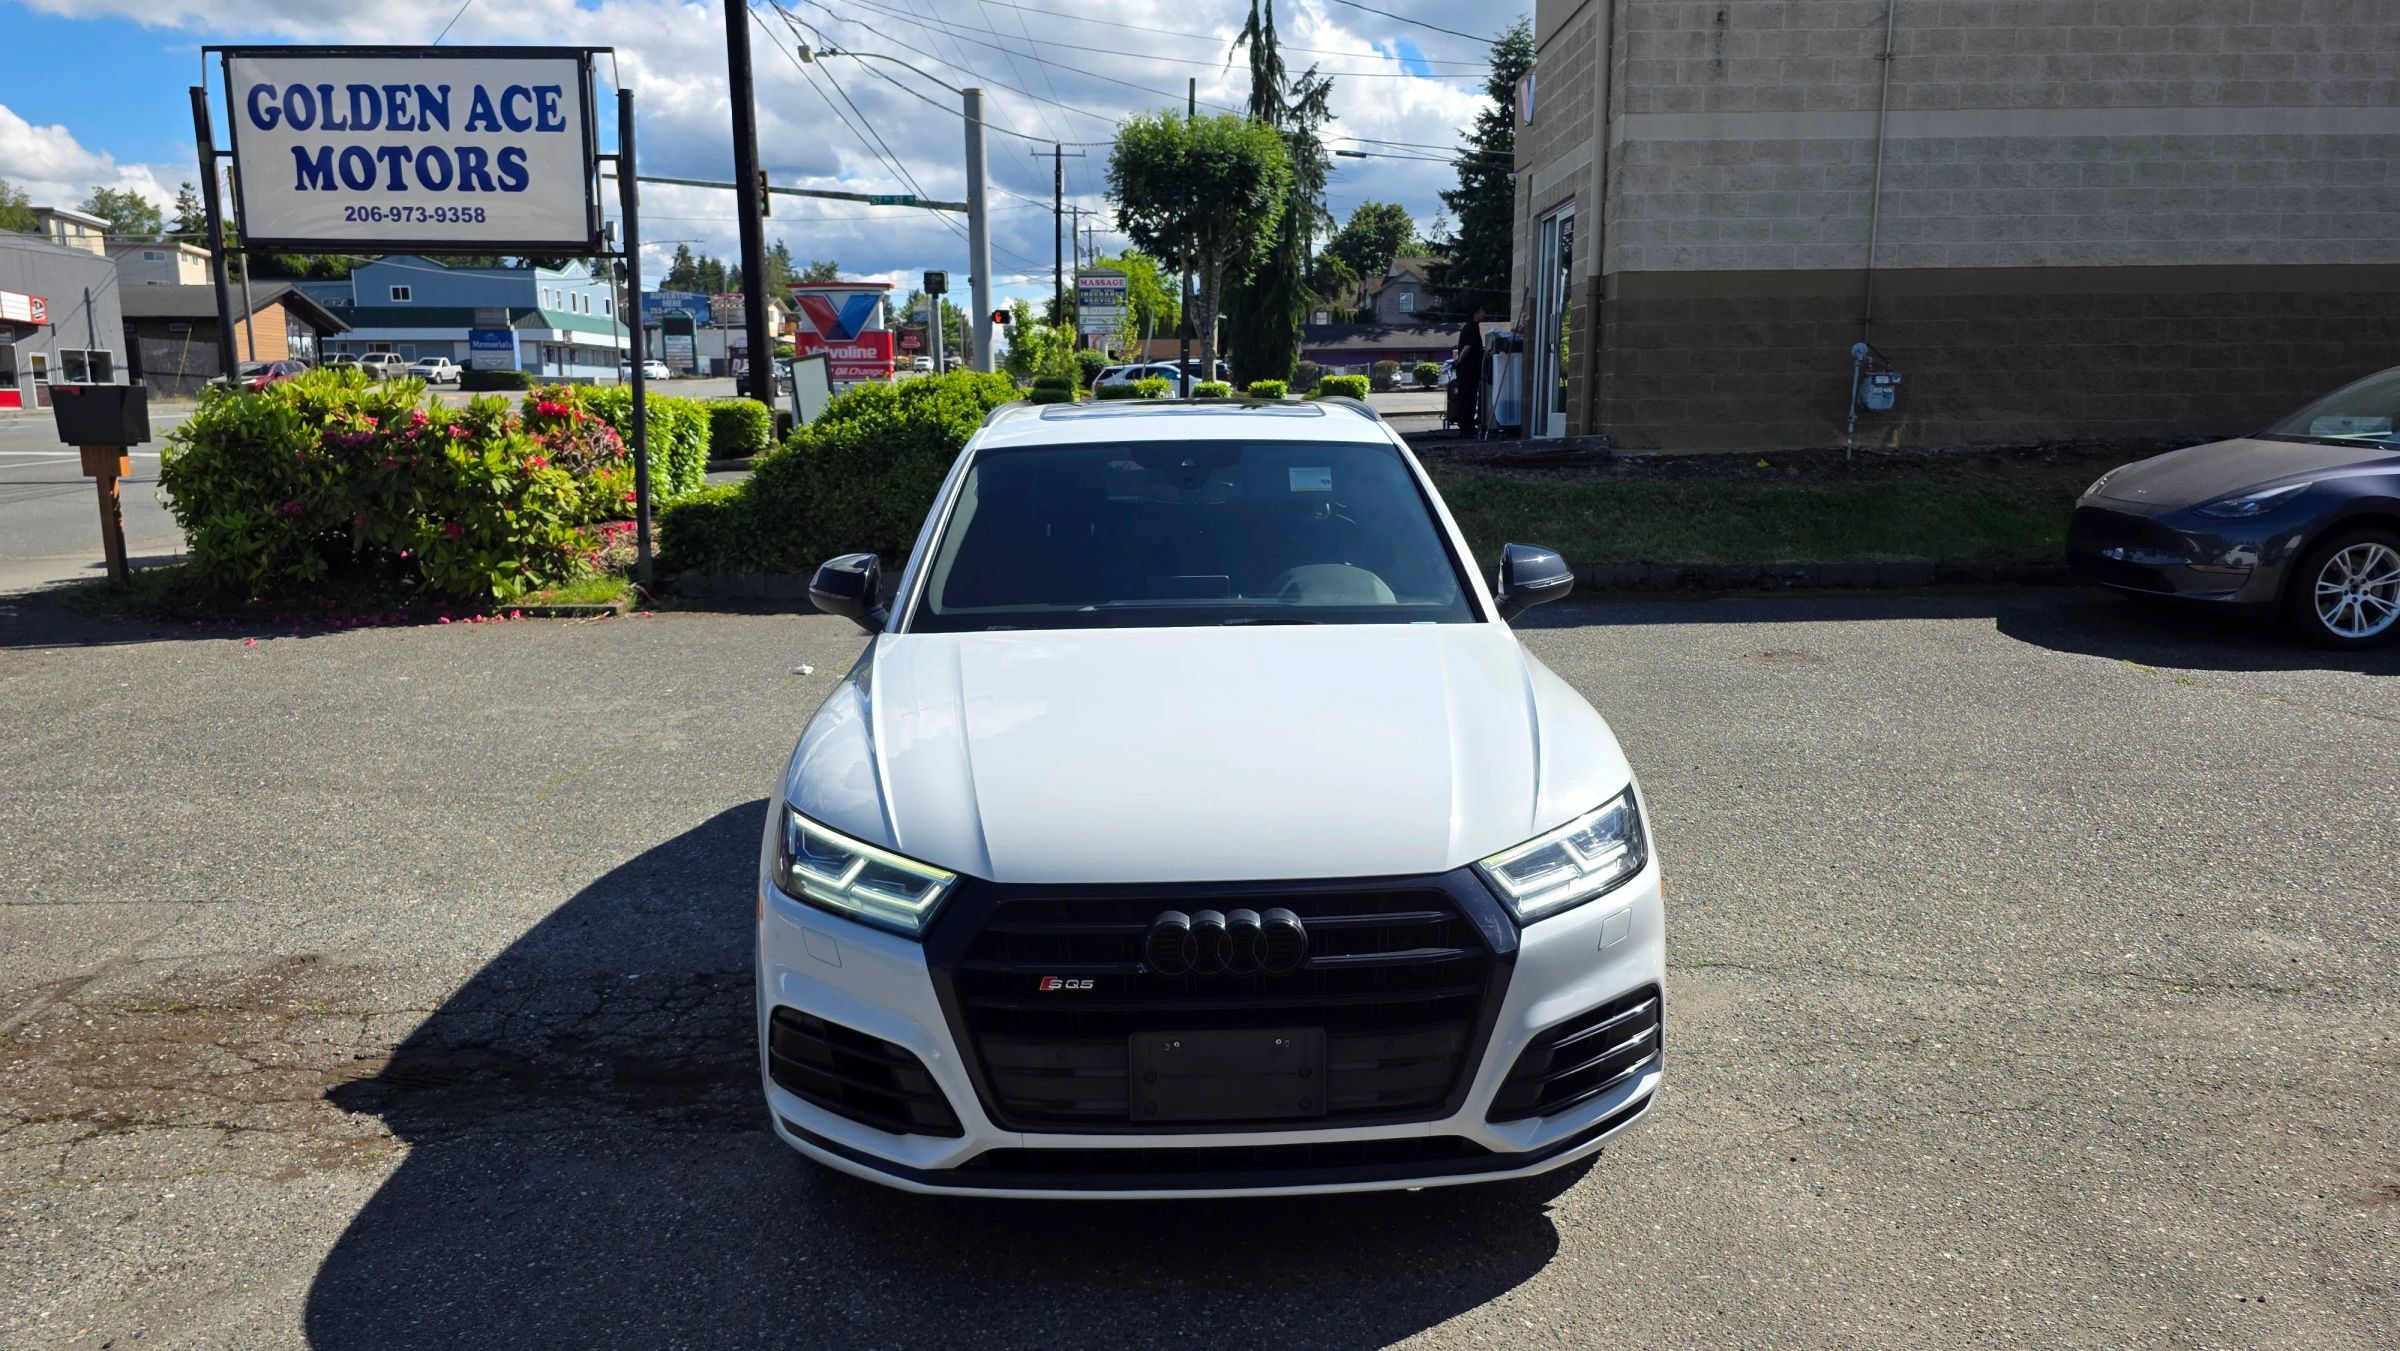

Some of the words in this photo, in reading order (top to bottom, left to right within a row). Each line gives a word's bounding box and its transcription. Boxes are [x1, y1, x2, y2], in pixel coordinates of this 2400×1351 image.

[247, 83, 451, 132] GOLDEN
[464, 84, 567, 132] ACE
[291, 145, 530, 192] MOTORS
[344, 205, 487, 223] 206-973-9358
[650, 292, 694, 300] ADVERTISE
[472, 340, 513, 349] Memorials
[835, 367, 849, 375] Oil
[849, 367, 884, 376] Change
